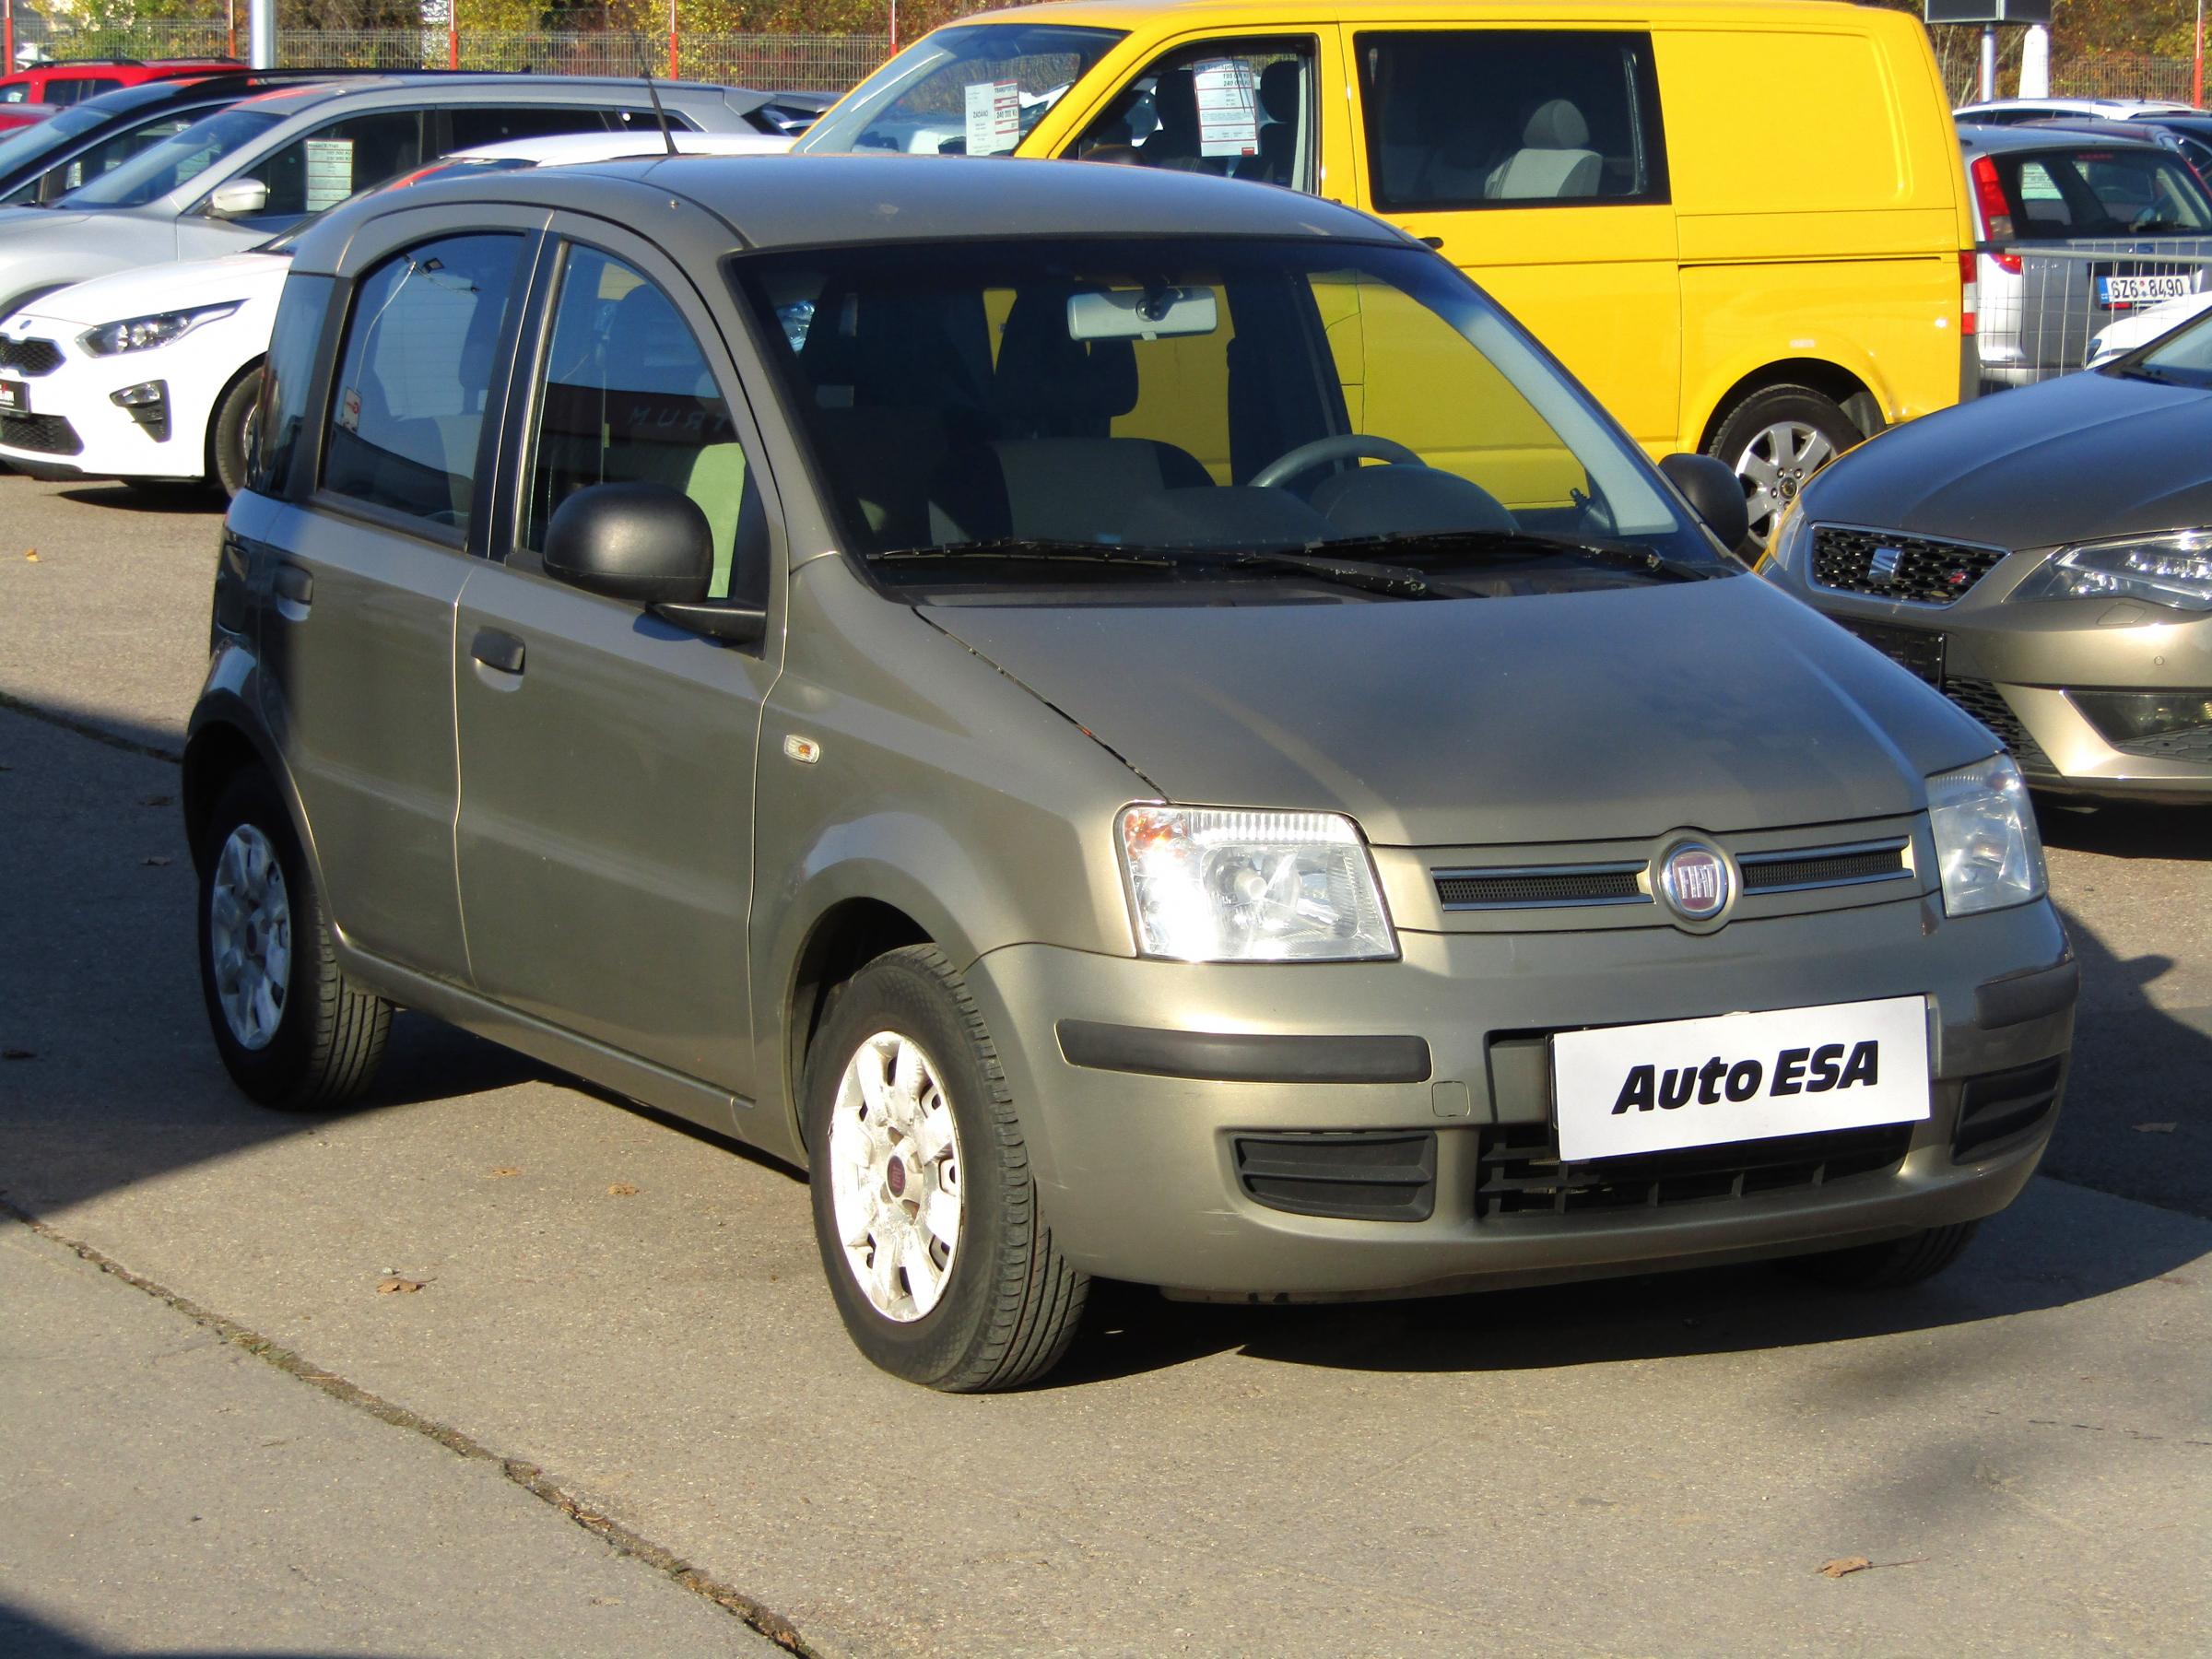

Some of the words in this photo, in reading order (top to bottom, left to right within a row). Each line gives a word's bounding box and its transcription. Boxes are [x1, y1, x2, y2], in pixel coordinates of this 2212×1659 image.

[1678, 864, 1714, 900] FIAT
[1611, 1056, 1763, 1115] Auto
[1769, 1040, 1878, 1097] ESA
